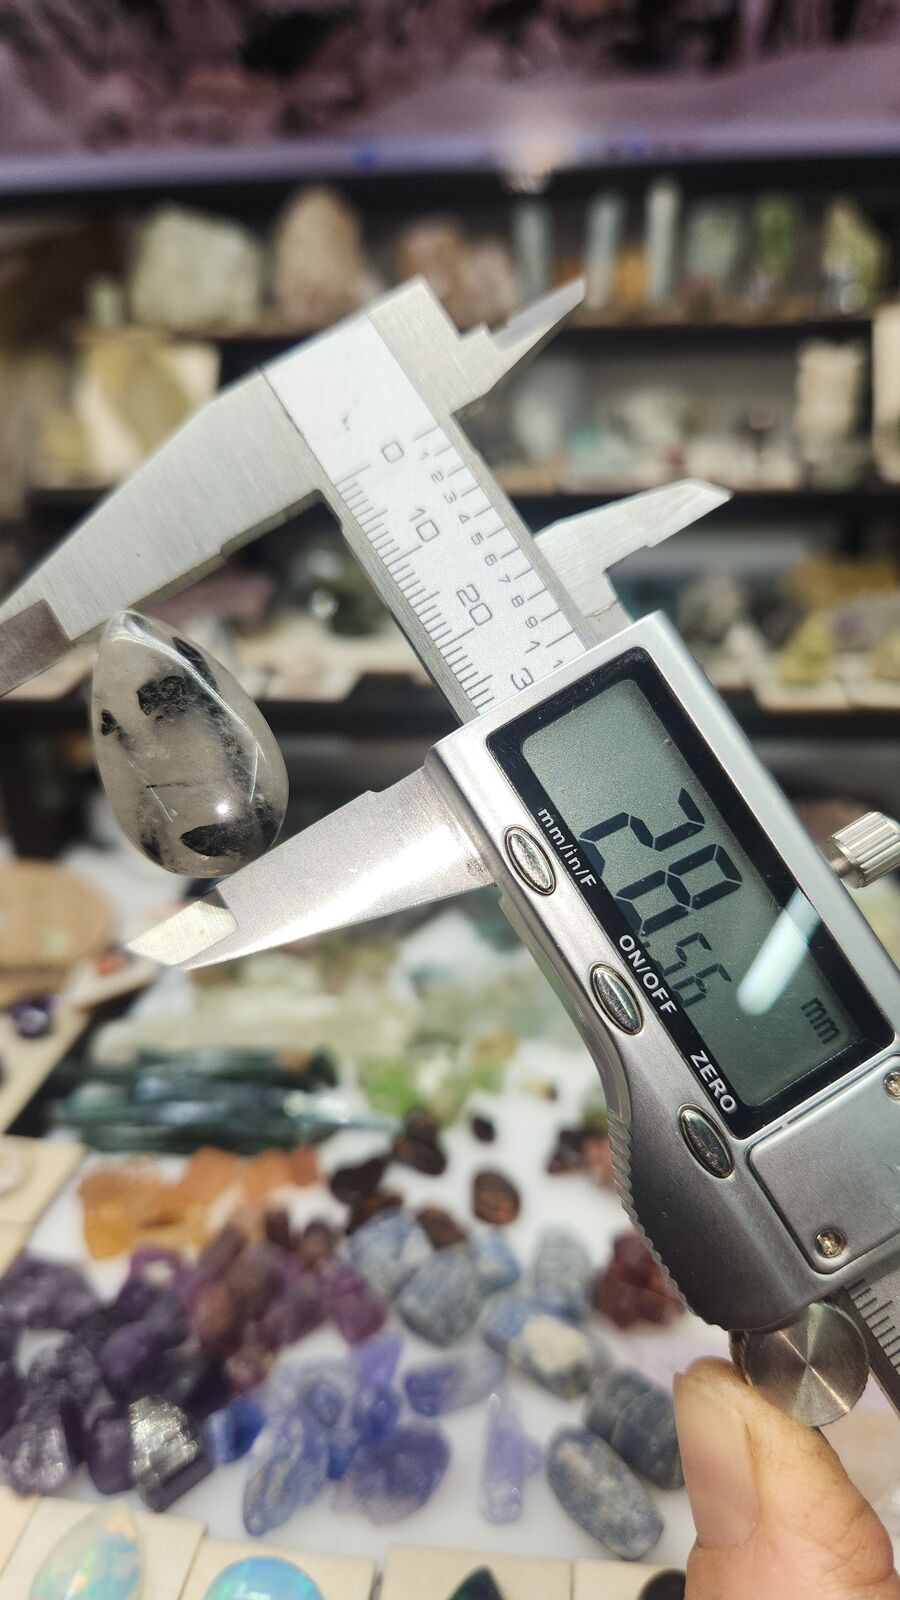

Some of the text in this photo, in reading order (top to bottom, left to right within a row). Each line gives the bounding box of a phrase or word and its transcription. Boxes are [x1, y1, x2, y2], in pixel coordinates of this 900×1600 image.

[381, 441, 404, 463] 0
[409, 508, 440, 542] 10
[456, 584, 493, 626] 20
[420, 451, 564, 669] 1 2 3 4 5 6 7 8 9 1 1
[537, 806, 597, 889] mm/in/F
[618, 934, 678, 1015] ON/OFF
[800, 996, 842, 1045] mm
[689, 1050, 738, 1115] ZERO
